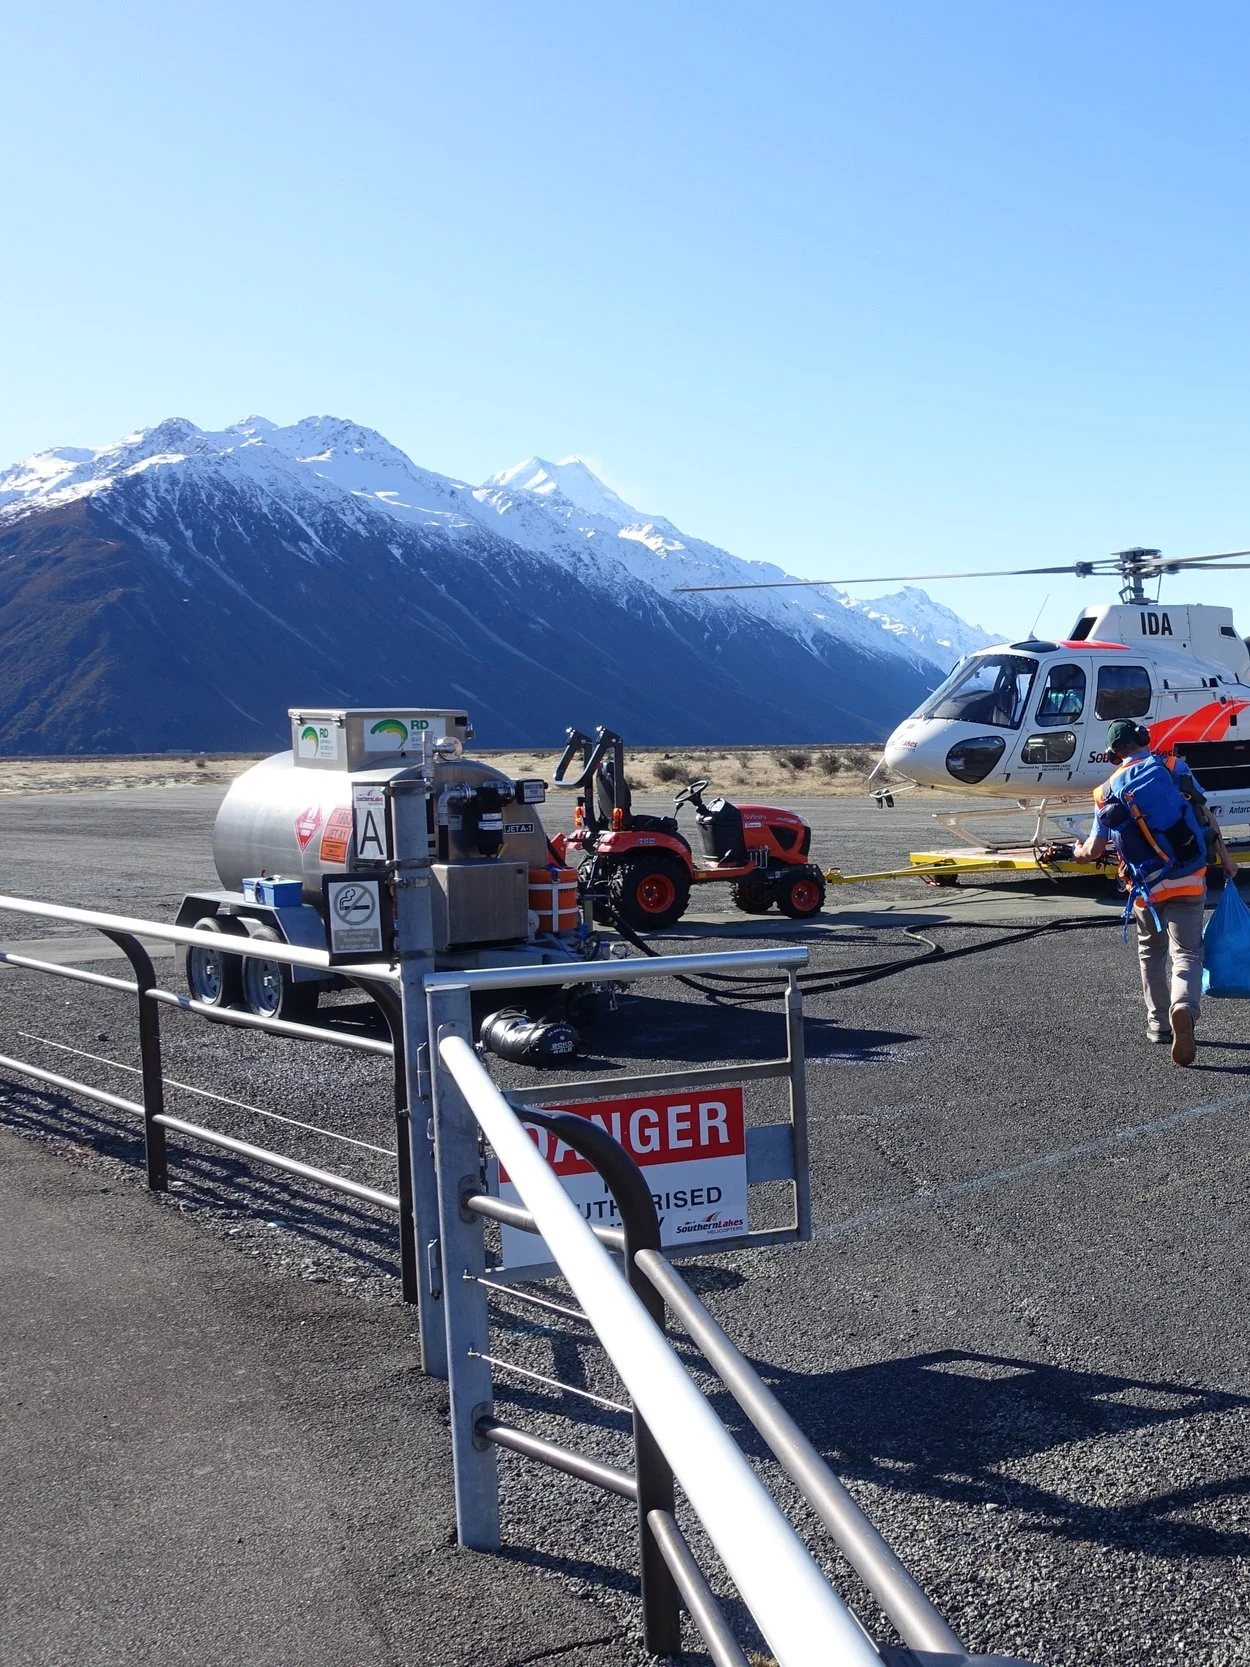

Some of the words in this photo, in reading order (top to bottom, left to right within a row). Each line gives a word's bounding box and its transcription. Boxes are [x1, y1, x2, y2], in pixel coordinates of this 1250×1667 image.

[1140, 612, 1173, 636] IDA
[411, 720, 429, 730] RD
[319, 728, 329, 738] RD
[359, 809, 385, 856] A
[507, 825, 520, 833] JET
[552, 1041, 573, 1050] 20KG
[577, 1186, 722, 1220] UTRISED
